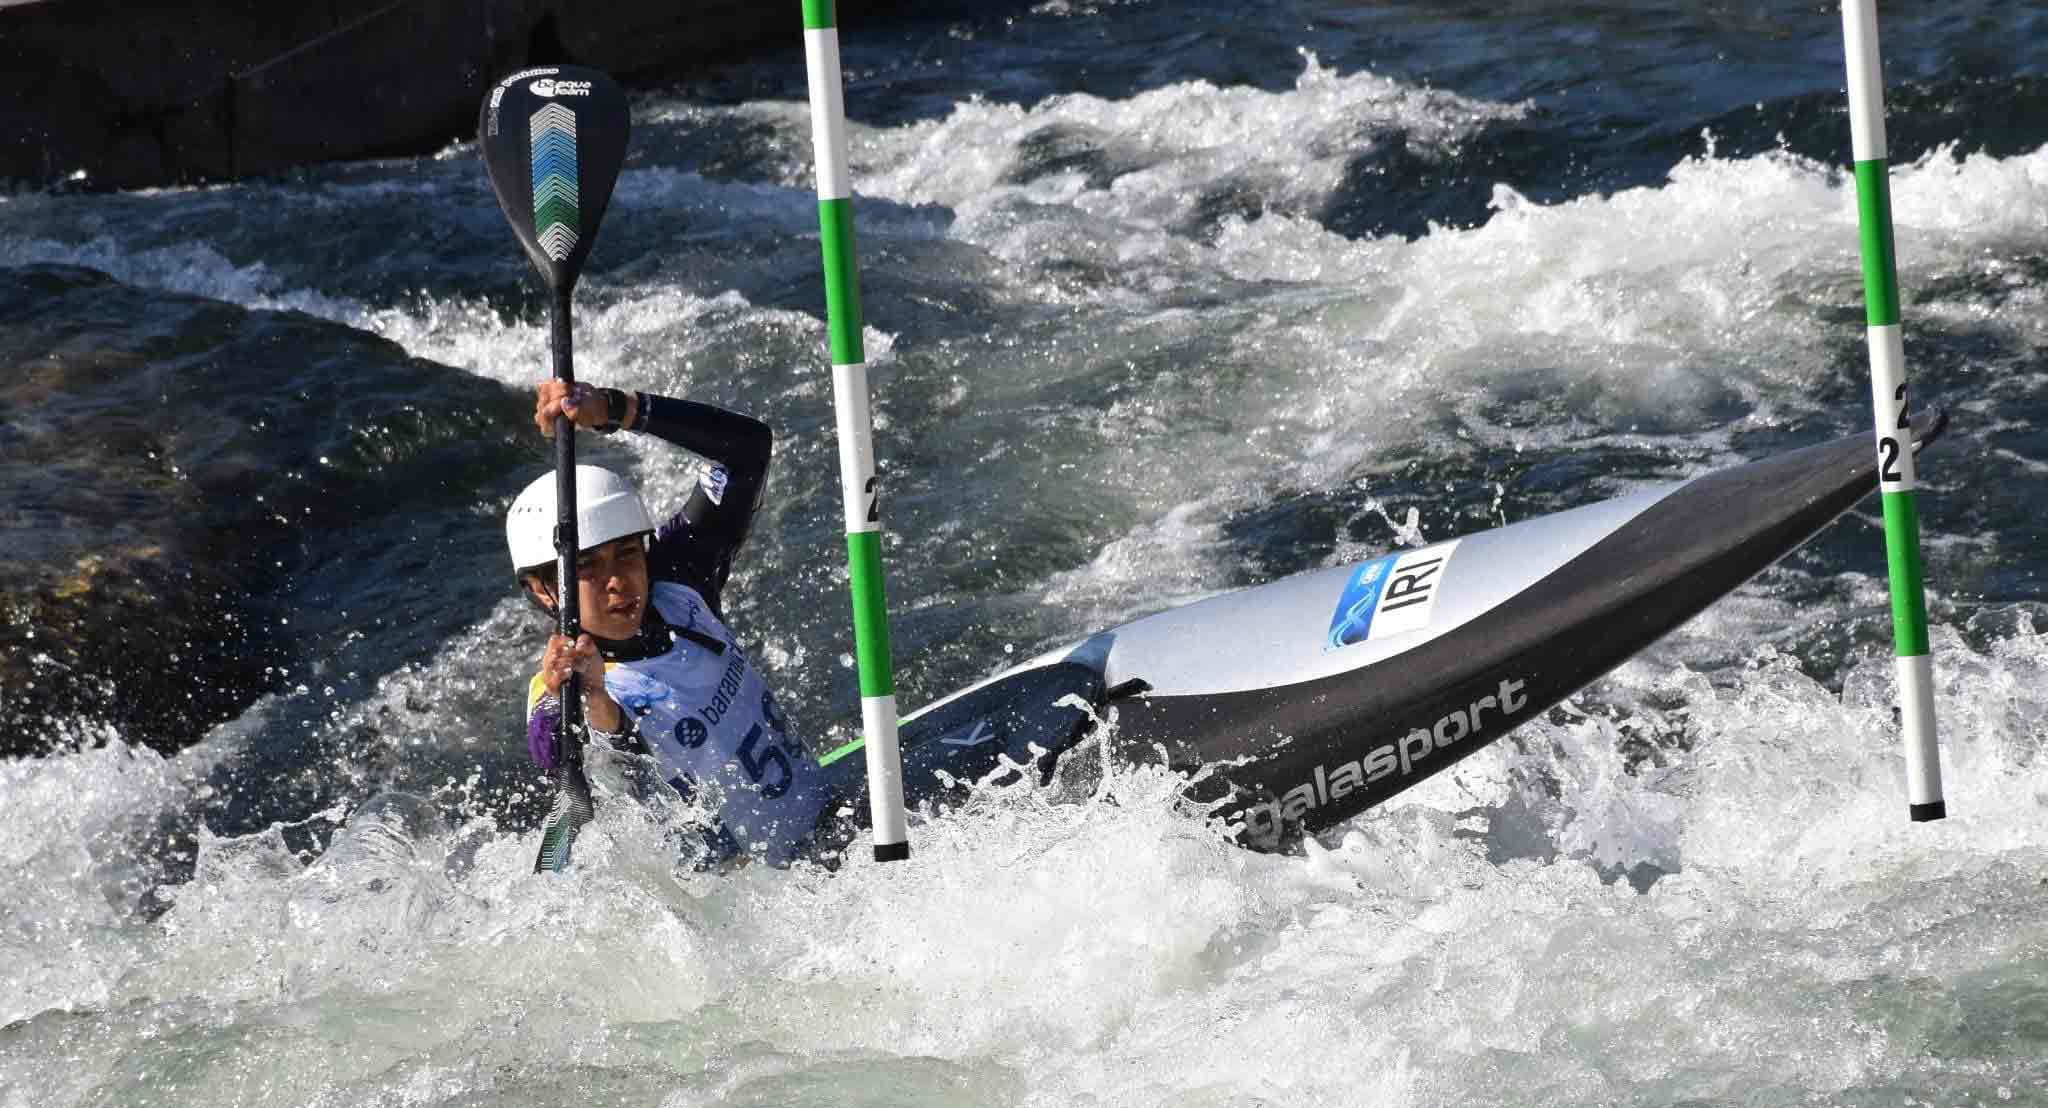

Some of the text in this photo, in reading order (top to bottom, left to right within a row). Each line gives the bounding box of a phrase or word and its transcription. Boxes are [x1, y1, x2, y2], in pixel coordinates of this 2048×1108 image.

[1879, 436, 1902, 482] 2
[1381, 557, 1443, 613] IRI
[1245, 677, 1528, 849] galasport
